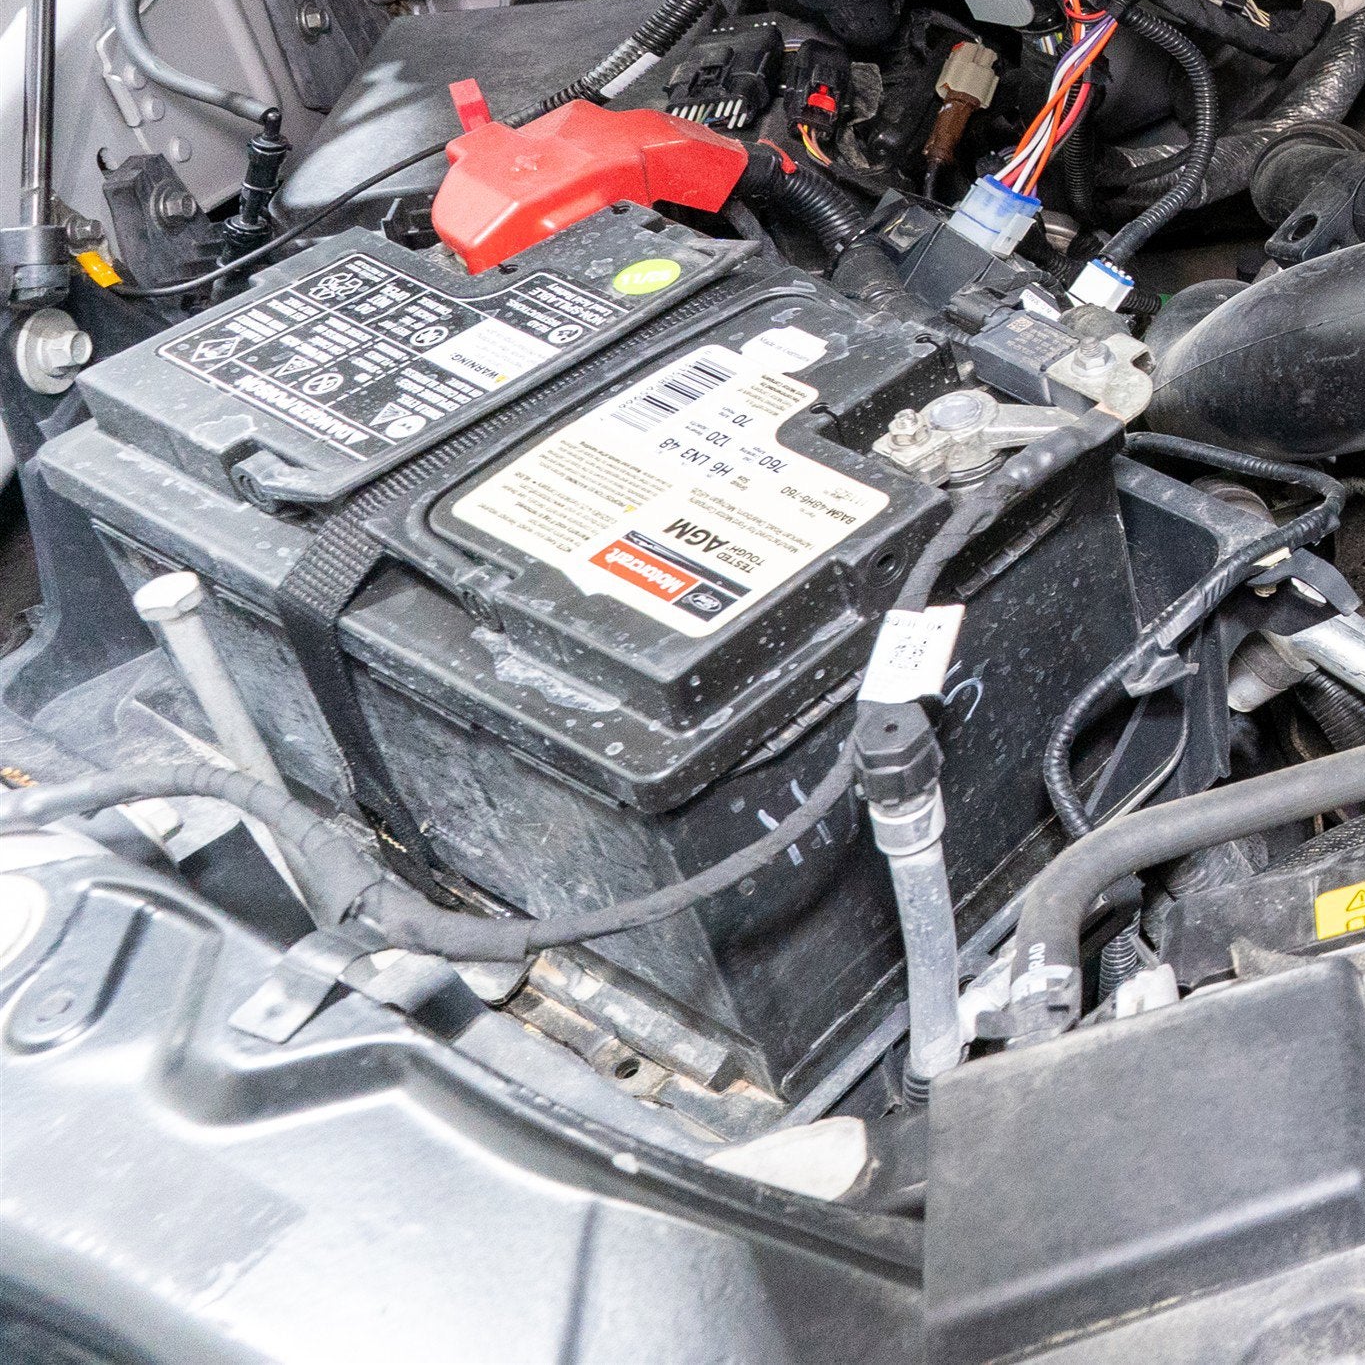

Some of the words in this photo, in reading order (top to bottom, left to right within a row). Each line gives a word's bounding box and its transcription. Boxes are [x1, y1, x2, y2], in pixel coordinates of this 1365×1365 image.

[365, 293, 395, 308] NOT
[525, 286, 609, 325] NON-SPILLABLE
[525, 319, 553, 332] READ
[446, 351, 501, 378] WARNING:
[232, 373, 357, 439] DANGER/POISON
[729, 413, 755, 427] 70
[657, 437, 683, 452] 48
[703, 430, 733, 447] 120
[678, 447, 712, 465] LN3
[756, 454, 790, 473] 760
[706, 460, 735, 476] H6
[778, 484, 857, 526] BAGM-48H6-760
[660, 517, 730, 555] AGM
[598, 546, 688, 593] Motorcraft
[714, 551, 756, 573] TESTED
